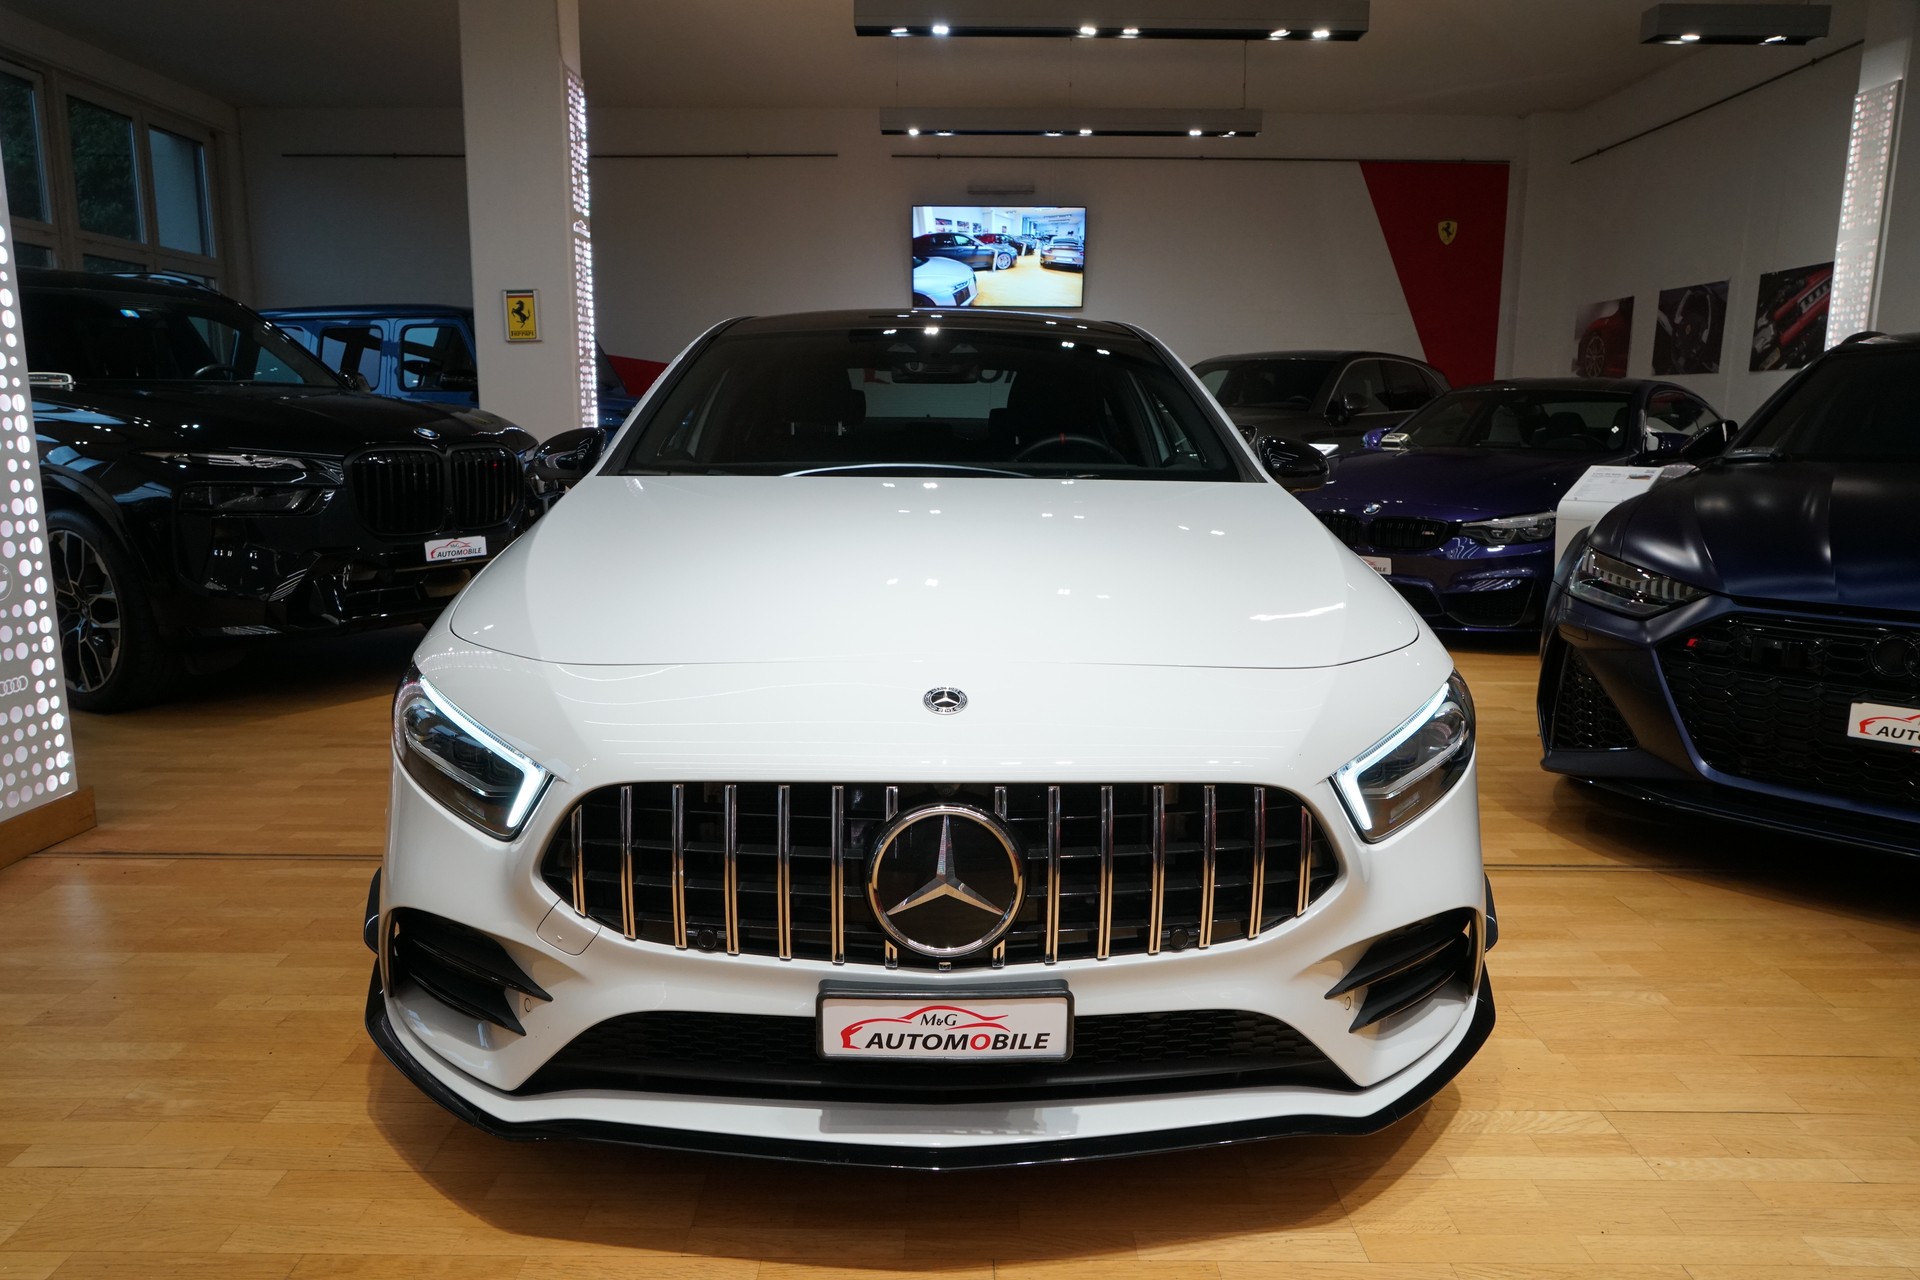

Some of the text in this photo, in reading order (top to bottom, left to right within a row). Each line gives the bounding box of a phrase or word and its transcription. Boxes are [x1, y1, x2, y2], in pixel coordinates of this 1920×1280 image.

[437, 547, 482, 558] AUTOMOBILE
[1876, 726, 1920, 742] AUT
[920, 1013, 957, 1027] M&G
[865, 1032, 1050, 1050] AUTOMOBILE
